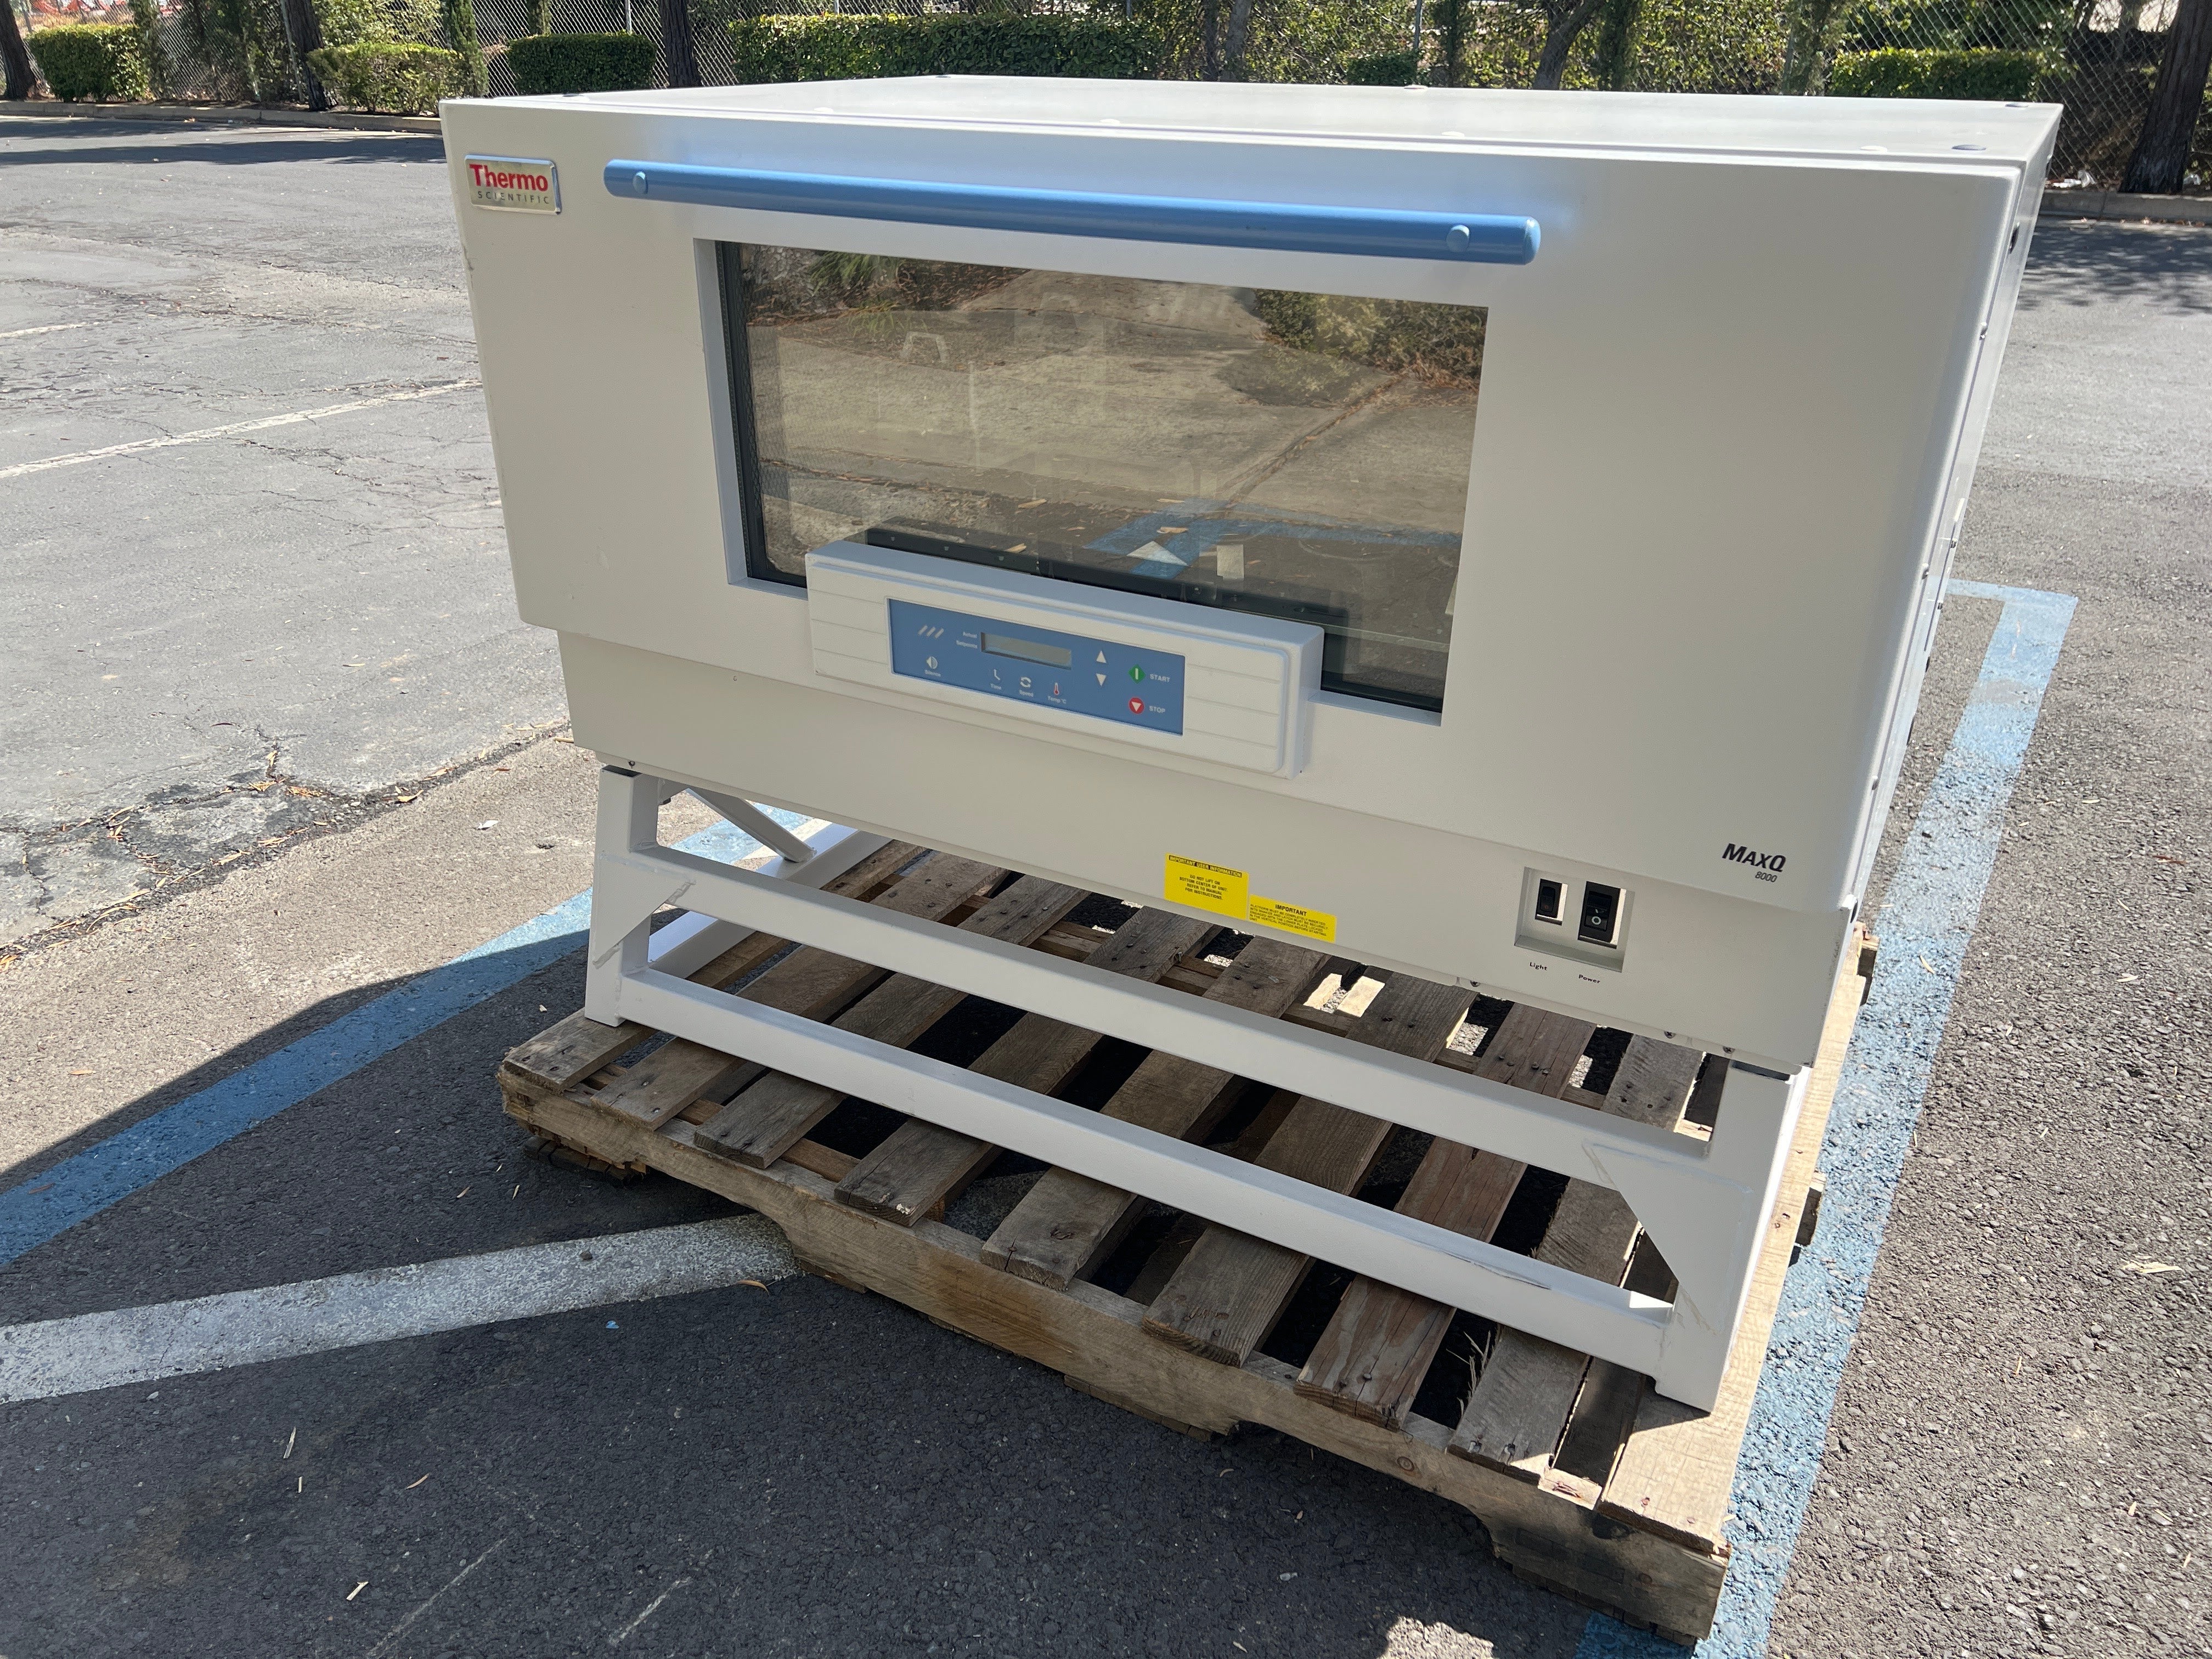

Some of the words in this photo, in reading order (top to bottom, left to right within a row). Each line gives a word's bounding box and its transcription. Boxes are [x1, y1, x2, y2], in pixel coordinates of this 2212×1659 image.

[469, 163, 548, 192] Thermo
[478, 191, 549, 204] SCIENTIFIC
[1149, 674, 1170, 682] START
[1019, 689, 1034, 697] Speed
[1047, 695, 1061, 703] Temp
[1170, 855, 1196, 866] IMPORTANT
[1210, 865, 1242, 878] INFORMATION
[1755, 871, 1778, 883] 8000
[1275, 904, 1307, 916] IMPORTANT
[1530, 962, 1548, 970] Light
[1578, 974, 1601, 984] Power
